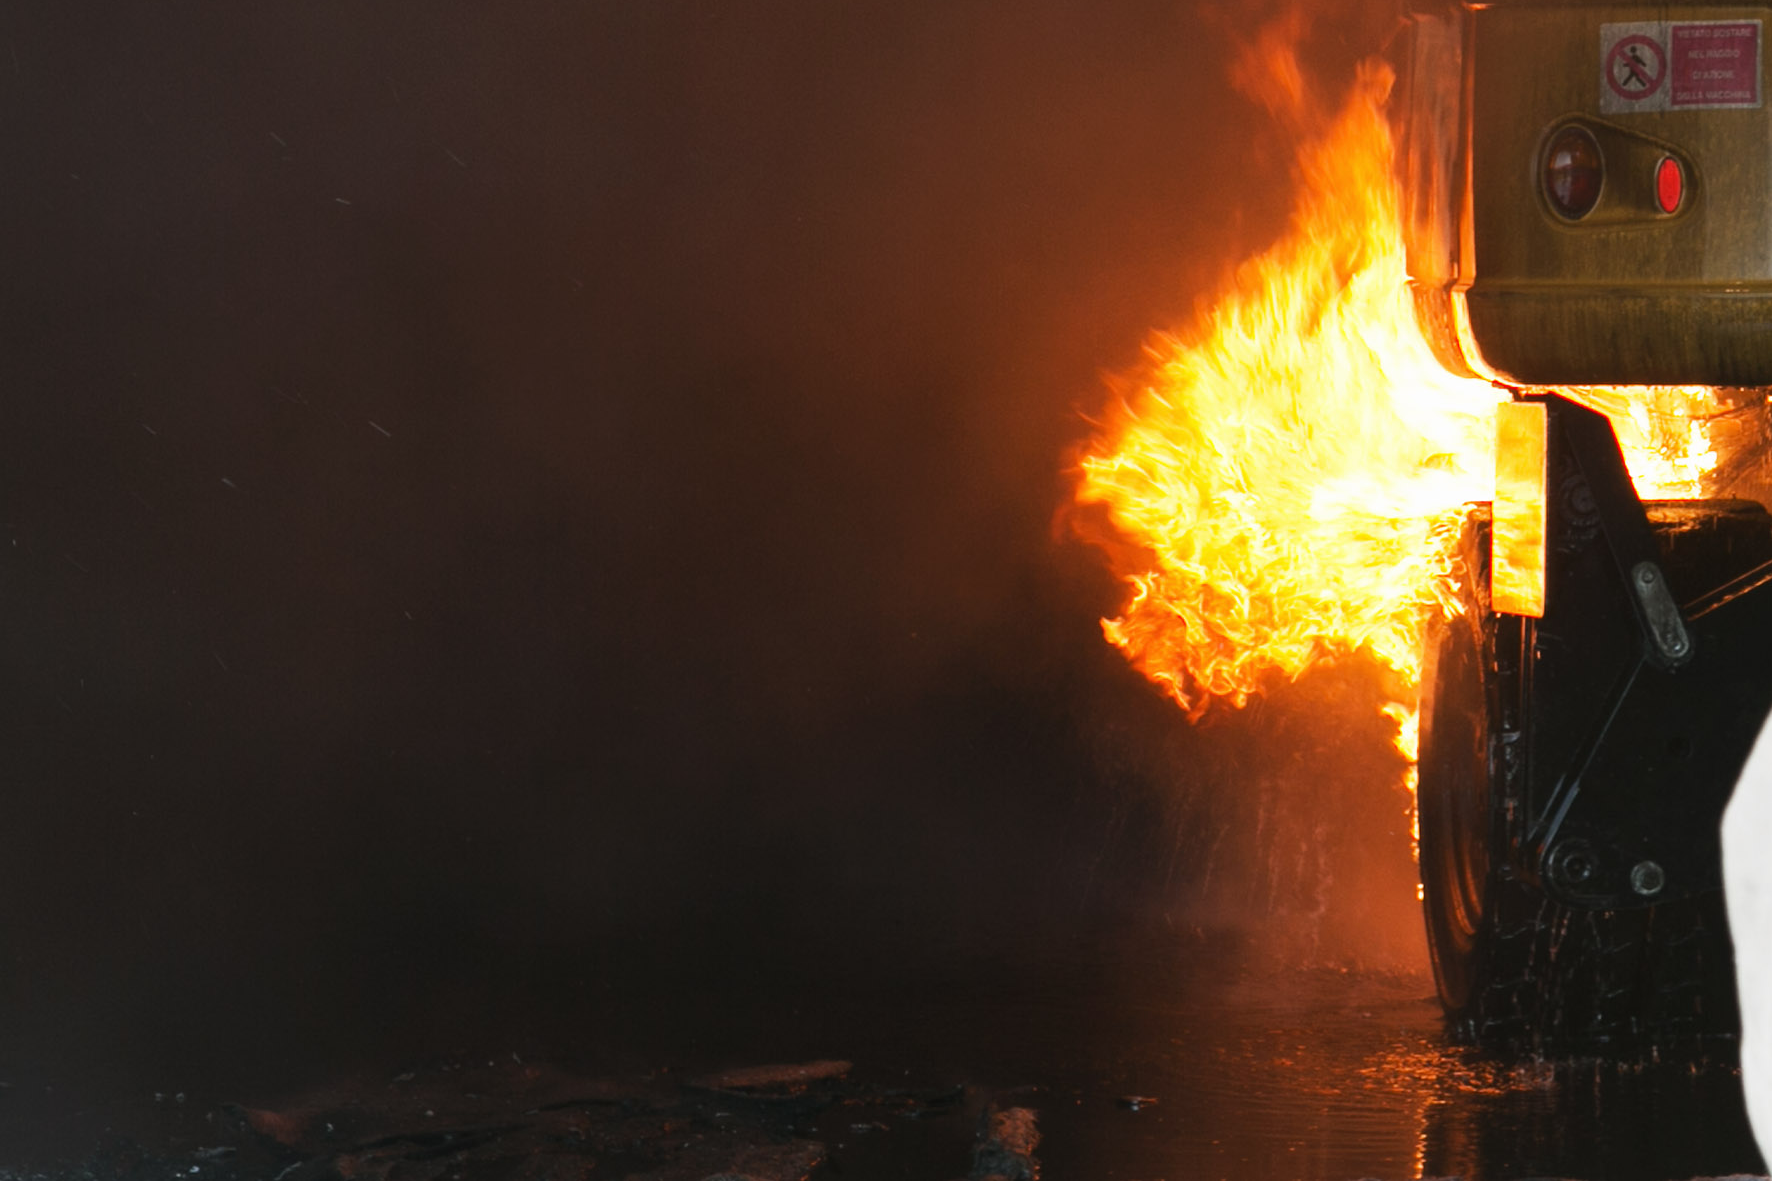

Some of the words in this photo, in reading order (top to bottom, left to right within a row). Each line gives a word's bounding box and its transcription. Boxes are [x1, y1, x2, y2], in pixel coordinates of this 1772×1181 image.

[1677, 28, 1711, 38] VIETATO
[1713, 27, 1752, 37] SOSTARE
[1705, 90, 1752, 100] MACCHINA
